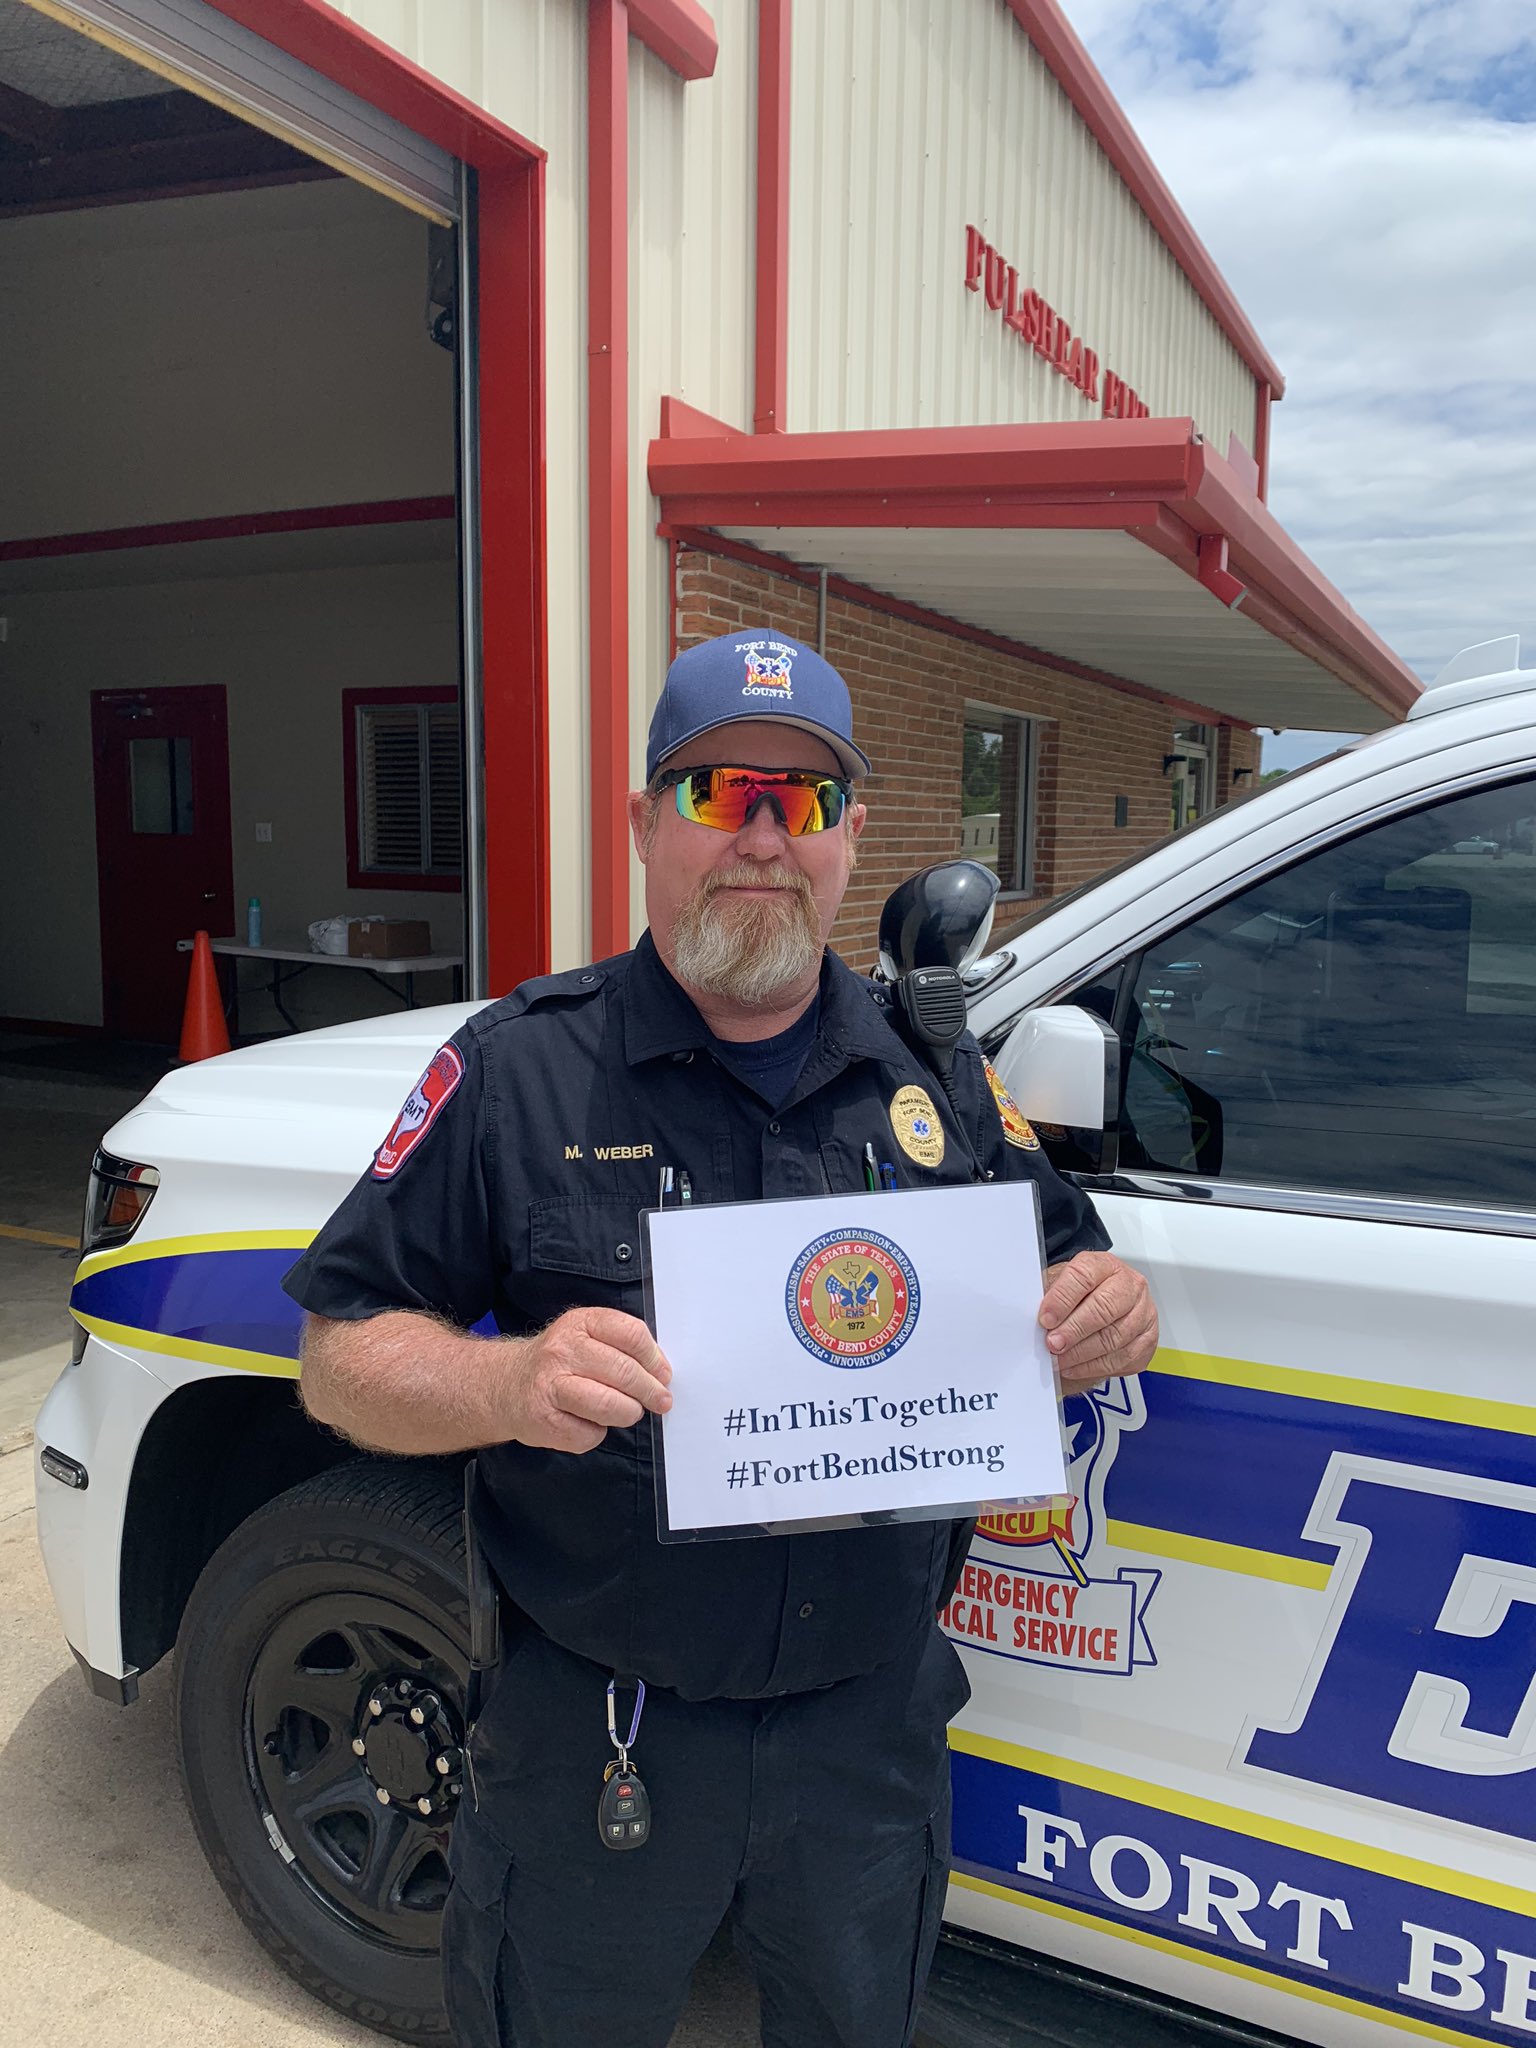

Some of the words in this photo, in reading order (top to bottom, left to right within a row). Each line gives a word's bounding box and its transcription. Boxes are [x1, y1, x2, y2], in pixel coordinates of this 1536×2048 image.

[964, 224, 1099, 402] FULSHEAR
[735, 641, 766, 653] FORT
[768, 641, 798, 657] BEND
[742, 687, 794, 700] COUNTY
[899, 1098, 930, 1108] PARAMEDIC
[903, 1108, 917, 1116] FORT
[565, 1145, 583, 1159] M.
[594, 1144, 654, 1160] WEBER
[909, 1136, 937, 1145] COUNTY
[797, 1237, 828, 1267] SAFETY
[830, 1230, 893, 1249] COMPASSION
[804, 1263, 821, 1285] THE
[821, 1245, 851, 1263] STATE
[854, 1244, 868, 1254] OF
[870, 1249, 898, 1278] TEXAS
[891, 1246, 918, 1292] EMPATHY
[788, 1270, 825, 1358] PROFESSIONALISM
[810, 1322, 836, 1350] FORT
[837, 1342, 867, 1353] BEND
[868, 1310, 903, 1348] COUNTY
[845, 1309, 865, 1318] EMS
[847, 1321, 865, 1330] 1972
[892, 1296, 919, 1349] TEAMWORK
[829, 1349, 887, 1367] INNOVATION
[723, 1387, 999, 1437] #InThisTogether
[726, 1443, 1005, 1489] #FortBendStrong
[273, 1539, 425, 1586] EAGLE
[954, 1564, 1079, 1620] ERGENCY
[939, 1600, 998, 1643] ICAL
[1013, 1615, 1118, 1662] SERVICE
[1017, 1805, 1354, 1970] FORT
